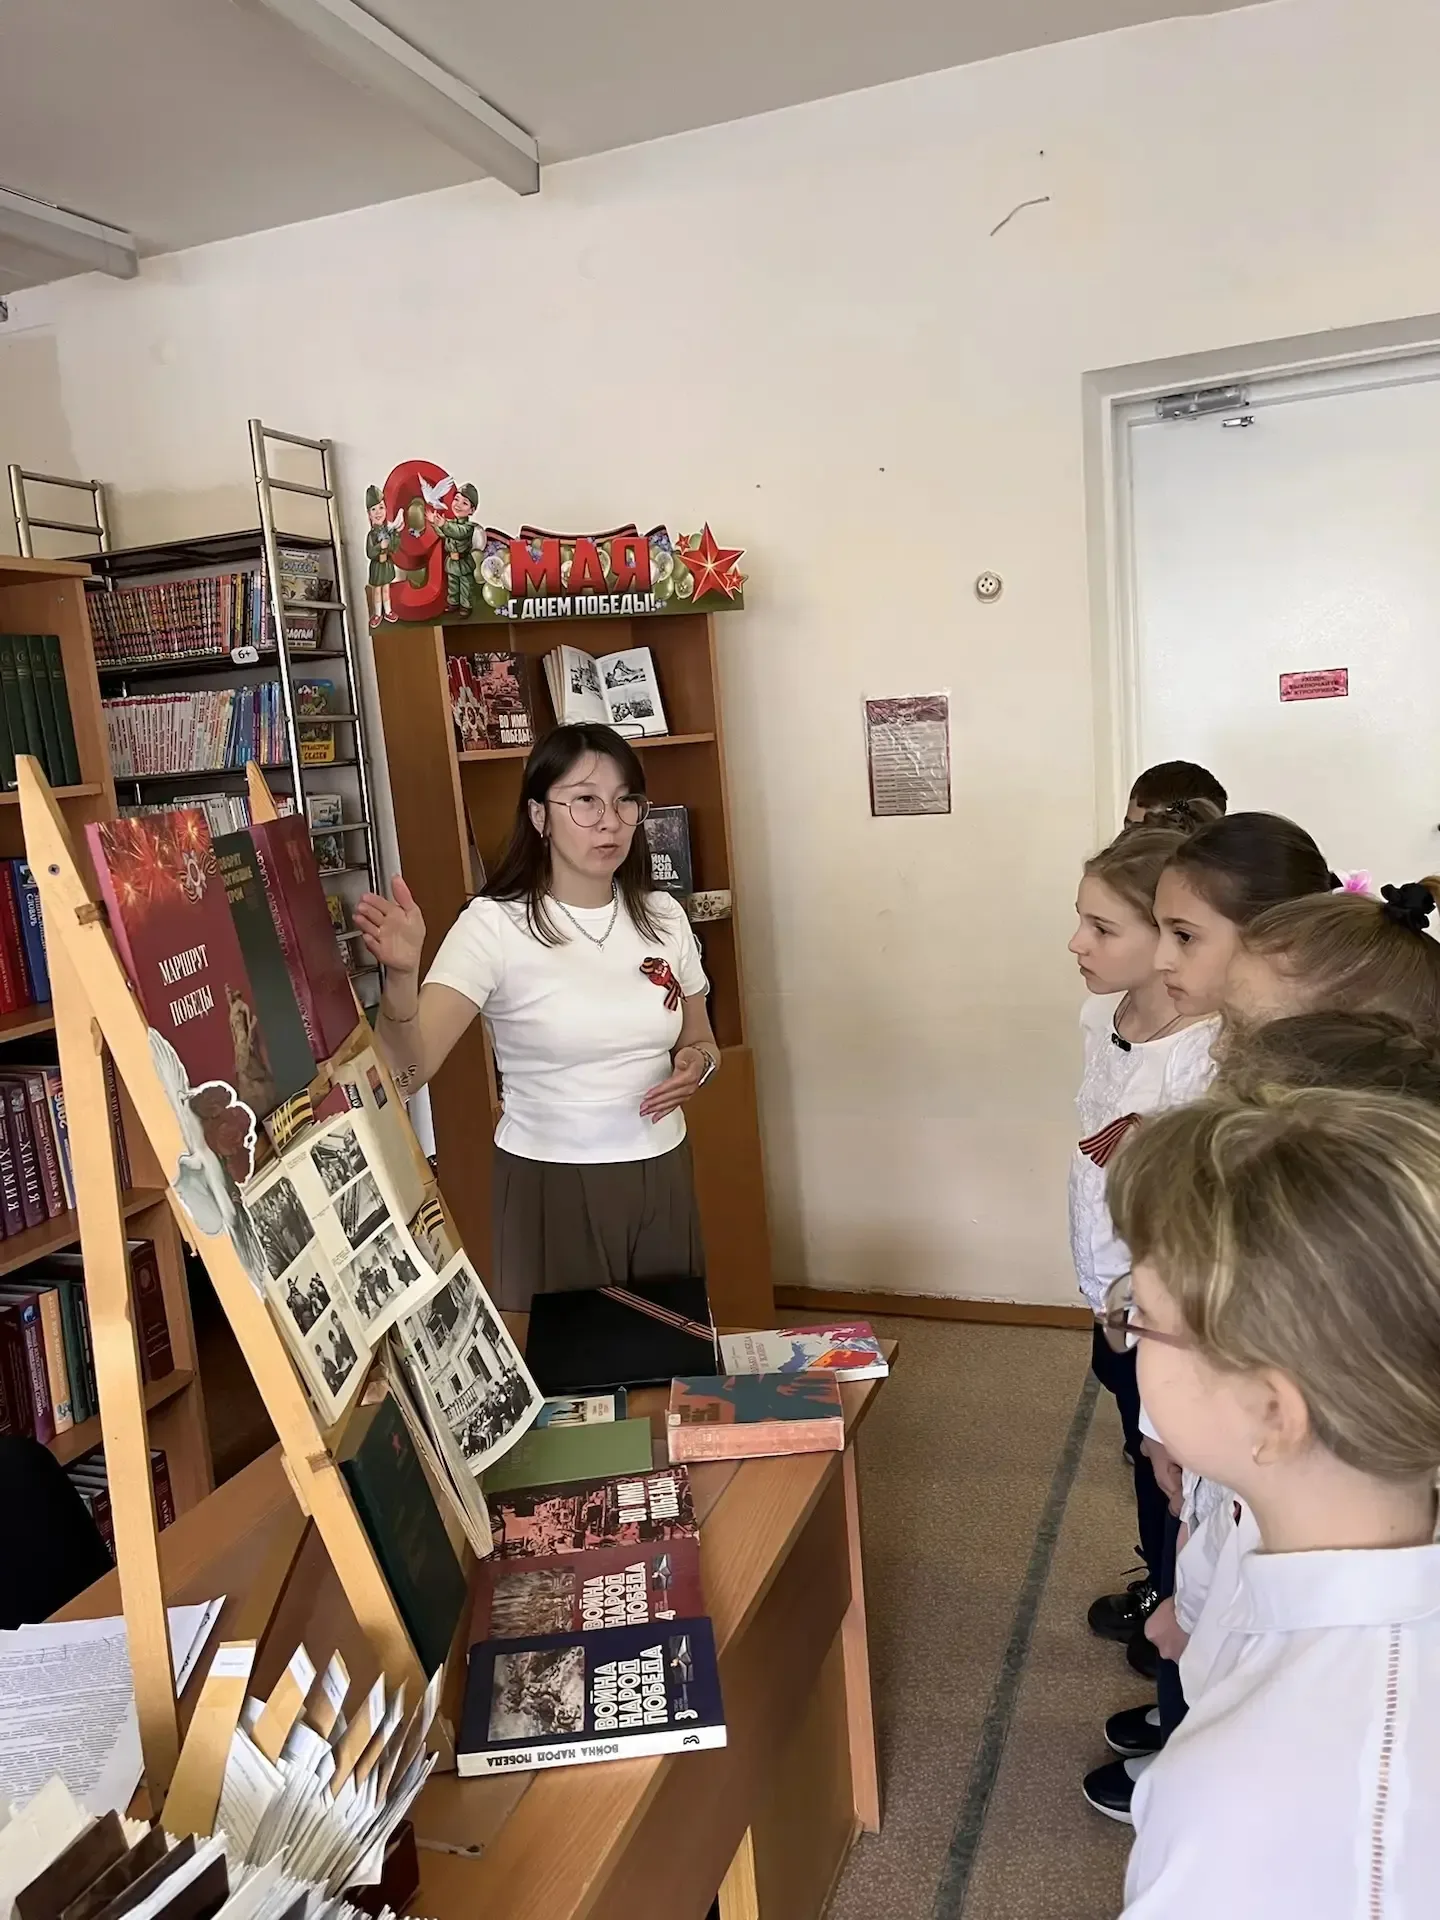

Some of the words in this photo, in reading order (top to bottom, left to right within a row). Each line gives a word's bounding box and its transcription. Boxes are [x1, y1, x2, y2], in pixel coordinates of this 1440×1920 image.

[381, 459, 459, 622] 9
[510, 537, 651, 597] МАЯ
[507, 598, 518, 618] С
[520, 596, 572, 619] ДНЕМ
[574, 593, 656, 617] ПОБЕДЫ!
[238, 649, 251, 659] 6+
[499, 714, 509, 729] ВО
[510, 713, 528, 728] ИМЯ
[501, 728, 531, 744] ПОБЕДЫ
[650, 853, 672, 863] ЙНА
[651, 862, 673, 872] РОД
[651, 870, 679, 881] БЕДА
[26, 893, 39, 927] СЛОВАРЬ
[158, 943, 209, 987] МАРШРУТ
[168, 984, 215, 1027] ПОБЕДЫ
[0, 1147, 20, 1212] ХИМИЯ
[19, 1140, 41, 1204] ХИМИЯ
[617, 1481, 646, 1507] ИМЯ
[647, 1476, 680, 1520] ПОБЕДЫ
[618, 1507, 648, 1524] ВО
[579, 1575, 605, 1631] ВОЙНА
[603, 1572, 627, 1628] НАРОД
[625, 1561, 649, 1625] ПОБЕДА
[655, 1609, 677, 1621] 4
[589, 1661, 619, 1731] ВОЙНА
[617, 1658, 644, 1728] НАРОД
[640, 1644, 669, 1725] ПОБЕДА
[674, 1709, 699, 1721] 3
[580, 1743, 620, 1757] ВОЙНА
[682, 1734, 700, 1746] 3
[486, 1753, 533, 1768] ПОБЕДА
[536, 1748, 577, 1763] НАРОД
